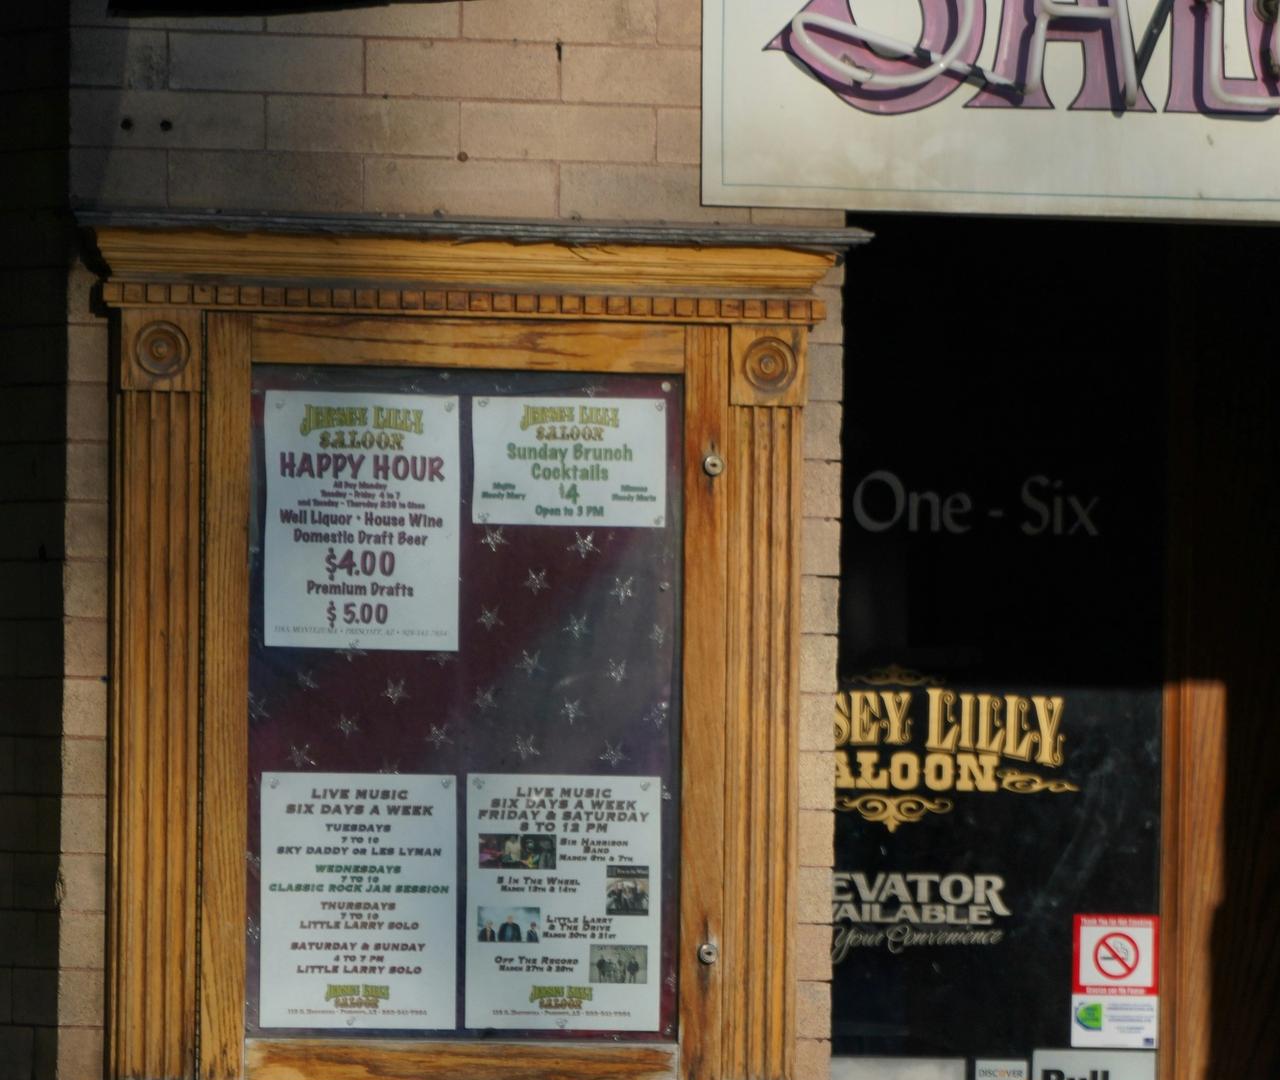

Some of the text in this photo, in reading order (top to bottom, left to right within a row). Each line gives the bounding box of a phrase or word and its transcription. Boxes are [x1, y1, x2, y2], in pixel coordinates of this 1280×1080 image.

[300, 404, 424, 437] JERSEY LILLY
[520, 404, 620, 431] JERSEY LILLY
[319, 430, 405, 450] SALOON
[536, 425, 604, 441] SALOON
[507, 442, 633, 463] Sunday Brunch
[280, 451, 446, 482] HAPPY HOUR
[531, 463, 609, 481] Cocktails
[559, 483, 580, 504] $4
[852, 470, 972, 534] One
[1020, 474, 1099, 537] Six
[280, 509, 443, 528] Well Liquor House Wine
[535, 505, 604, 518] Open to 3 PM
[294, 528, 428, 546] Domestic Draft Beer
[325, 547, 396, 581] $4.00
[307, 580, 414, 597] Premium Drafts
[926, 687, 1066, 768] LILLY
[311, 789, 408, 800] LIVE MUSIC
[516, 787, 612, 798] LIVE MUSIC
[285, 804, 434, 816] SIX DAYS A WEEK
[490, 799, 637, 810] SIX DAYS A WEEK
[478, 810, 649, 822] FRIDAY & SATURDAY
[325, 824, 391, 832] TUESDAYS
[520, 822, 608, 832] 8 TO 12 PM
[315, 864, 402, 874] WEDNESDAYS
[269, 884, 449, 894] CLASSIC ROCK JAM SESSION
[320, 901, 396, 910] THURSDAYS
[299, 921, 419, 930] LITTLE LARRY SOLO
[290, 942, 357, 950] SATURDAY
[374, 943, 426, 951] SUNDAY
[886, 925, 1003, 954] Convenience
[296, 965, 422, 975] LITTLE LARRY SOLO
[978, 1069, 1023, 1078] DISCOVER
